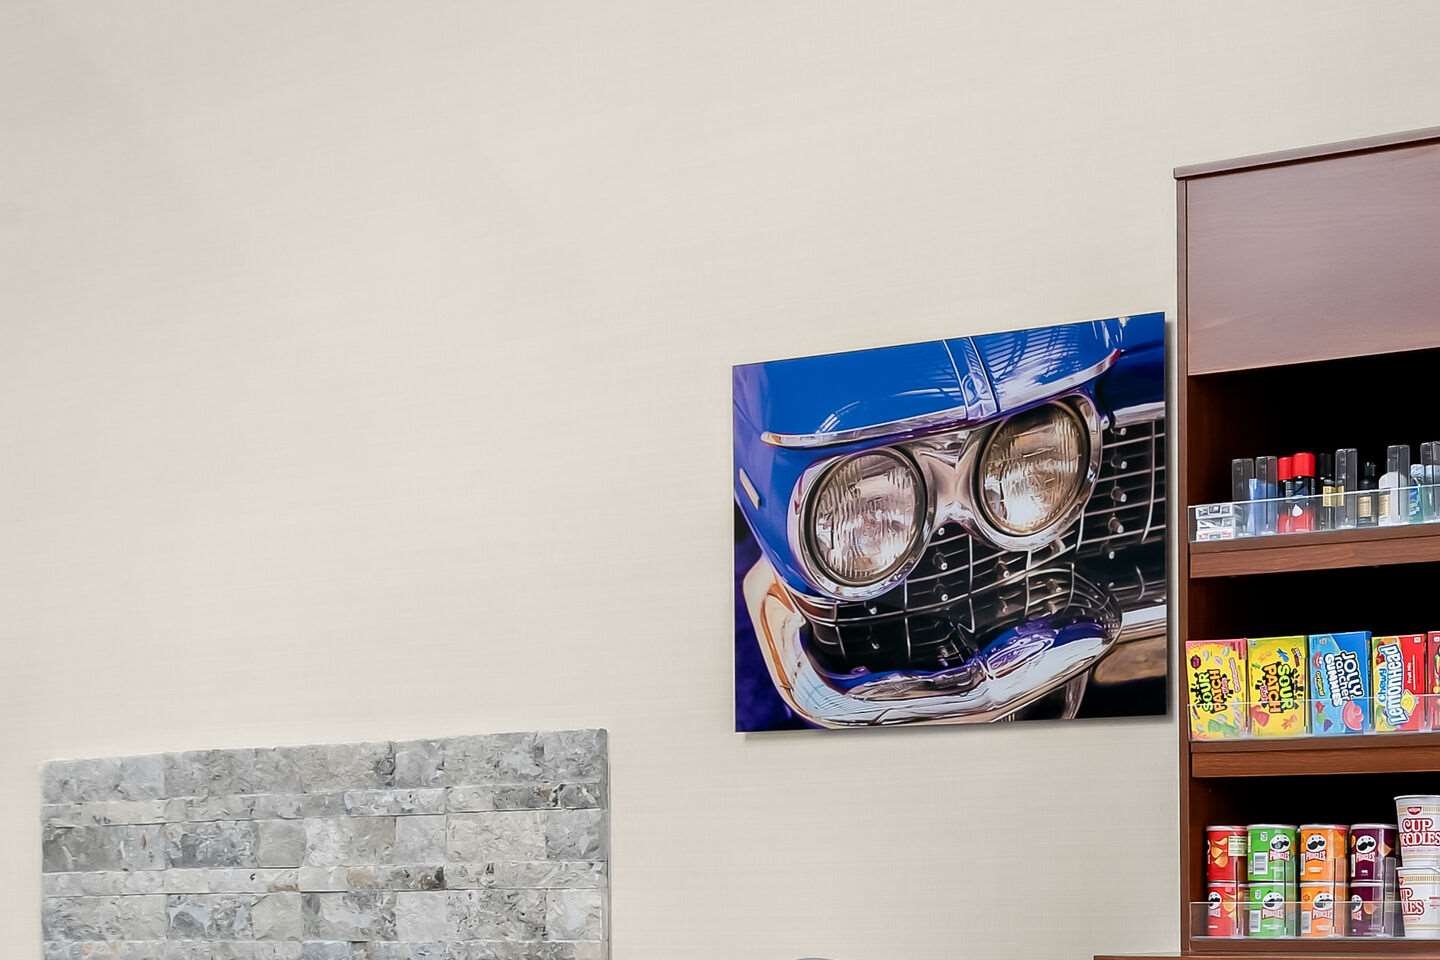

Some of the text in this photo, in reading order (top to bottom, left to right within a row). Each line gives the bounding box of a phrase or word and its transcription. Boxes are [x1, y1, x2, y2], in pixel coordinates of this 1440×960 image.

[1199, 672, 1214, 712] SOUR
[1208, 669, 1227, 712] PATCH
[1263, 663, 1282, 712] PATCH
[1278, 664, 1294, 709] SOUR
[1325, 654, 1342, 706] GUMMIES
[1335, 656, 1350, 701] rancher
[1342, 651, 1364, 696] JOLLY
[1377, 668, 1387, 704] Chewy
[1402, 818, 1433, 832] CUP
